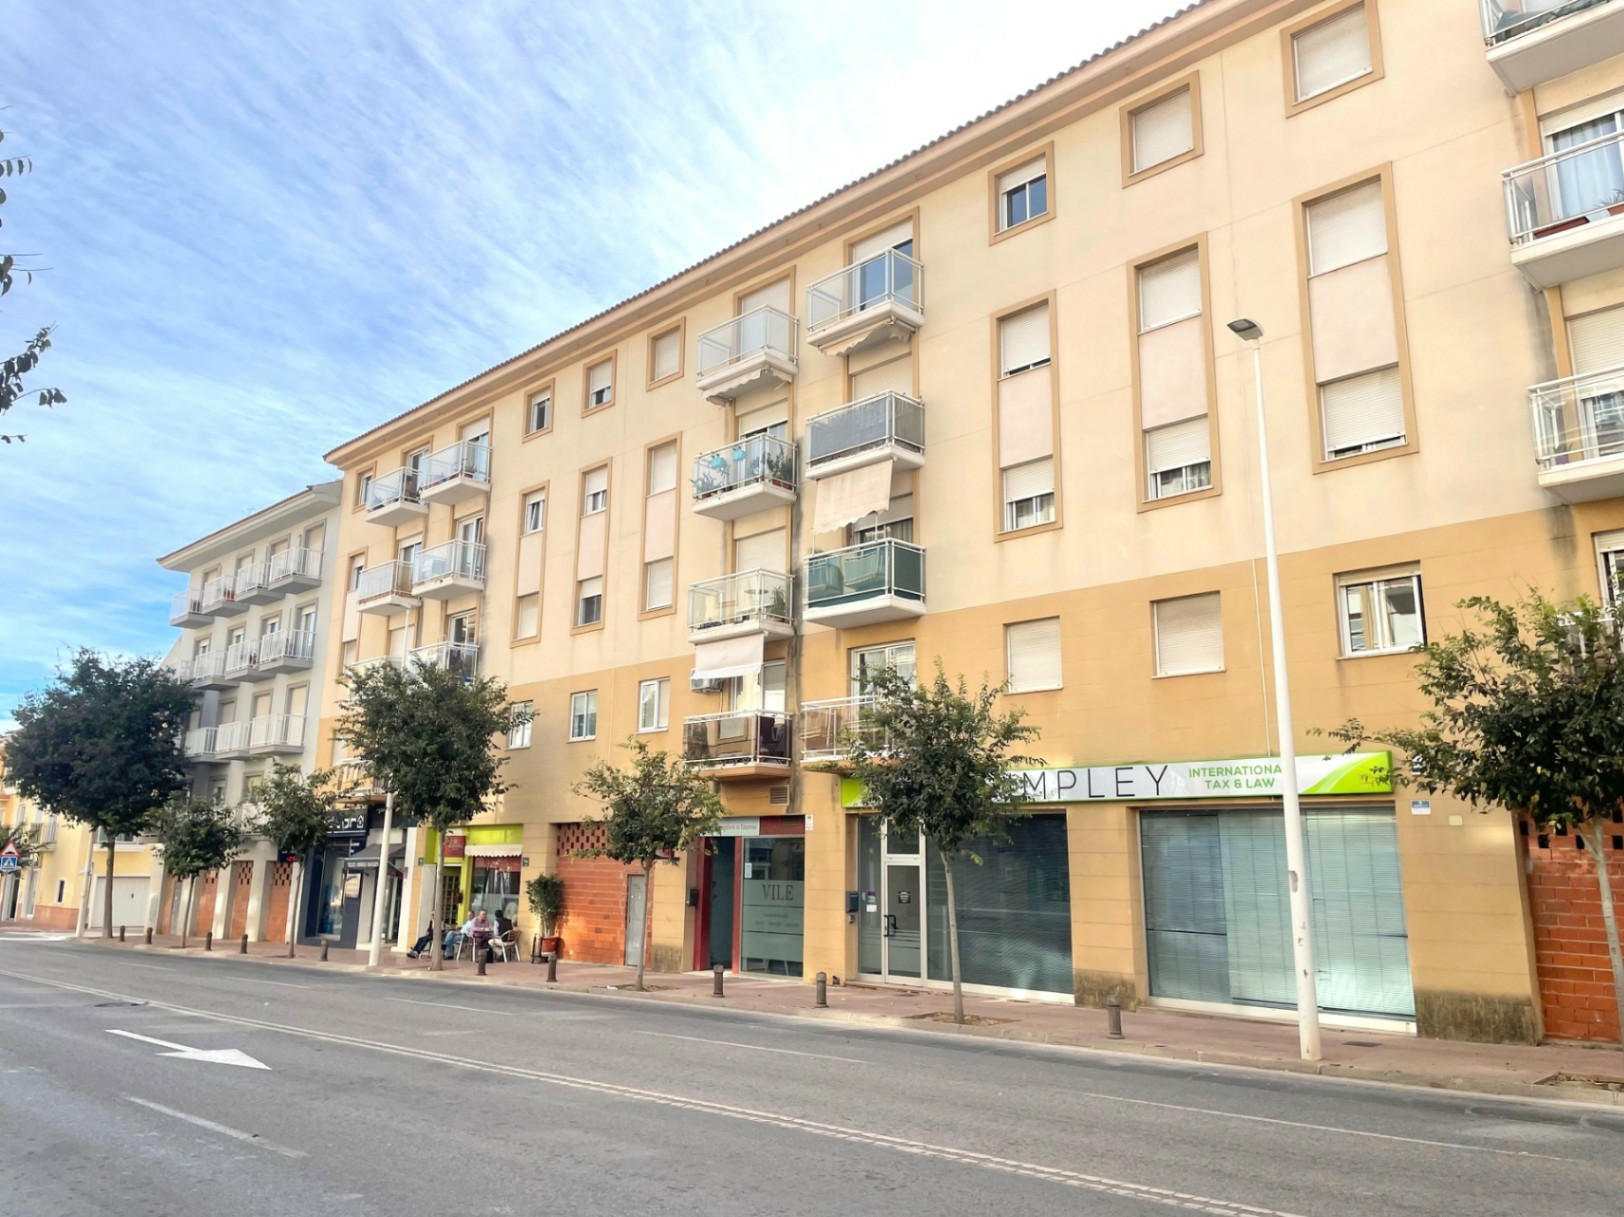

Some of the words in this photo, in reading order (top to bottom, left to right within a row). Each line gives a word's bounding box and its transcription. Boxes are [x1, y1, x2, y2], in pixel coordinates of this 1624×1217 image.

[1189, 764, 1282, 778] INTERNATIONA
[1022, 764, 1169, 800] MPLEY
[1205, 779, 1230, 790] TAX
[1234, 779, 1242, 788] &
[1246, 777, 1275, 789] LAW
[762, 884, 794, 901] VILE
